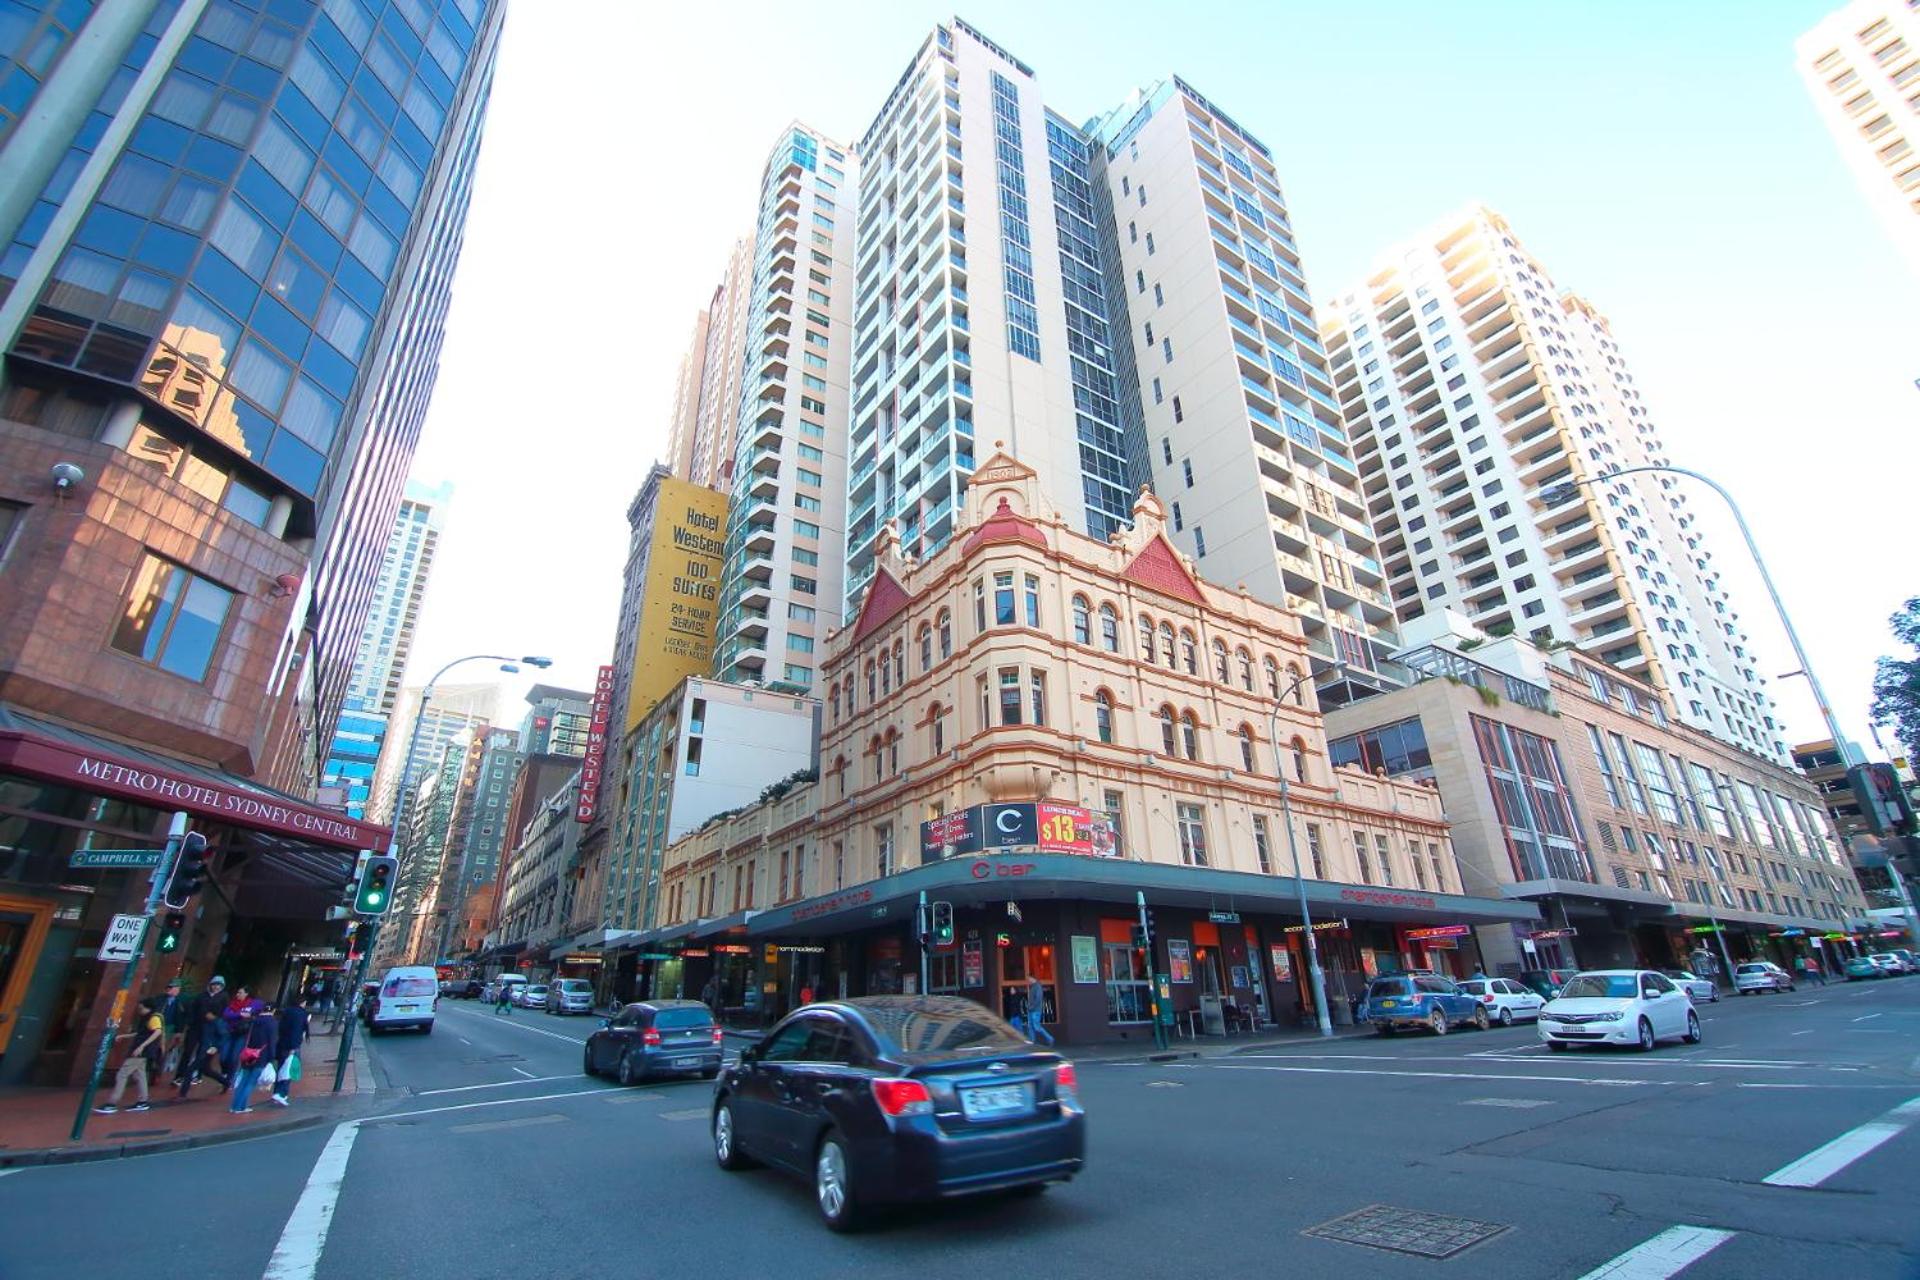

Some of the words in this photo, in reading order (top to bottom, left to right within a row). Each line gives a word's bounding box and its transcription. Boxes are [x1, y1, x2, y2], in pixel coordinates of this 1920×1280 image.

[687, 507, 719, 532] Hotel
[687, 560, 708, 579] 100
[671, 616, 705, 633] SERVICE
[592, 669, 613, 724] HOTEL
[577, 733, 602, 817] WESTEND
[77, 758, 157, 790] METRO
[160, 776, 221, 809] HOTEL
[225, 795, 292, 825] SYDNEY
[294, 813, 358, 841] CENTRAL
[996, 809, 1023, 833] C
[87, 855, 142, 864] CAMPBELL
[146, 855, 159, 864] ST
[971, 860, 990, 879] C
[995, 862, 1036, 876] bar
[117, 918, 141, 931] ONE
[111, 932, 137, 944] WAY
